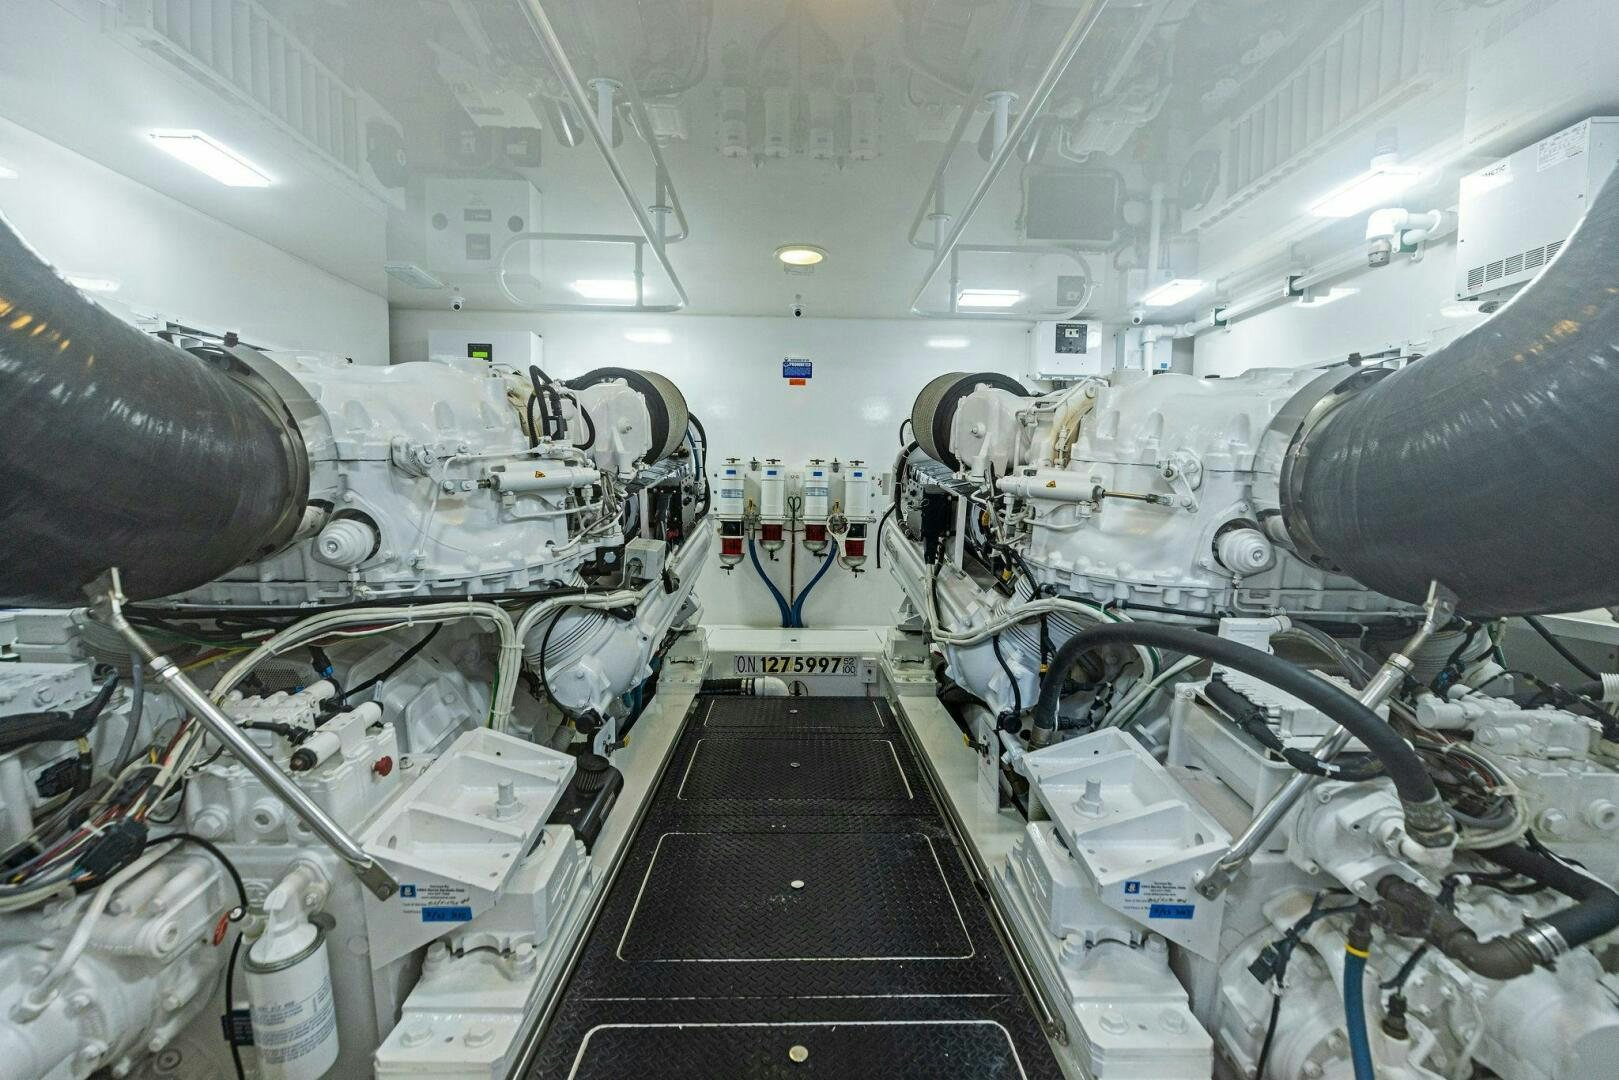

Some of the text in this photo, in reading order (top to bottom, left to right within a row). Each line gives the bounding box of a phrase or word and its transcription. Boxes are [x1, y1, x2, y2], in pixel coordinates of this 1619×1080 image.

[761, 656, 842, 674] 1275997
[843, 657, 855, 665] 52
[842, 665, 856, 674] 100
